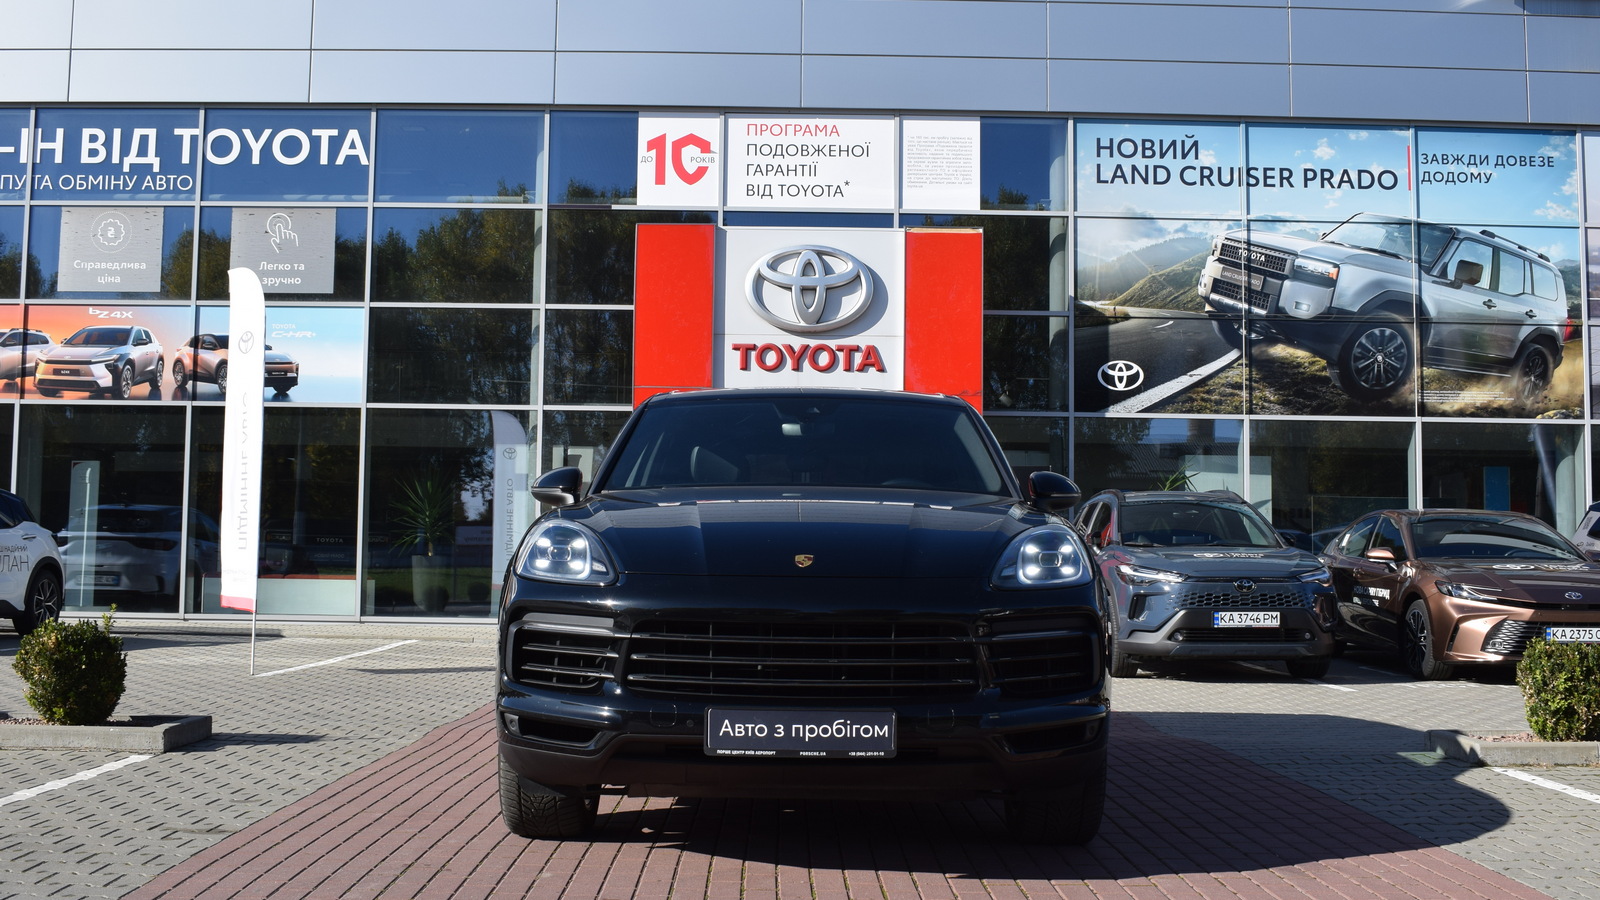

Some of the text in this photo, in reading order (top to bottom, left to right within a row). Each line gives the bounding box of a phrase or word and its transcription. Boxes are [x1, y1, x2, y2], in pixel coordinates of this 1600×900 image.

[746, 123, 841, 137] ПРОГРАМА
[80, 128, 161, 173] ВІД
[173, 128, 370, 166] TOYOTA
[746, 141, 871, 160] ПОДОВЖЕНОЇ
[1096, 134, 1200, 160] НОВИЙ
[640, 133, 716, 186] ДО 10 РОКІВ
[1420, 152, 1556, 170] ЗАВЖДИ ДОВЕЗЕ
[746, 161, 819, 177] ГАРАНТІЇ
[1096, 163, 1399, 191] LAND CRUISER PRADO
[0, 174, 193, 191] ПУ ТА ОБМІНУ АВТО
[1420, 170, 1493, 186] ДОДОМУ
[746, 183, 773, 200] ВІД
[73, 259, 147, 272] Справедлива
[259, 261, 305, 273] Легко та
[97, 273, 121, 286] ціна
[261, 277, 302, 287] зручно
[88, 307, 134, 319] bZ4X
[732, 343, 885, 373] TOYOTA
[1237, 613, 1261, 624] 3746
[1262, 613, 1279, 624] PM
[1569, 629, 1593, 640] 2375
[719, 719, 889, 742] Авто з пробігом
